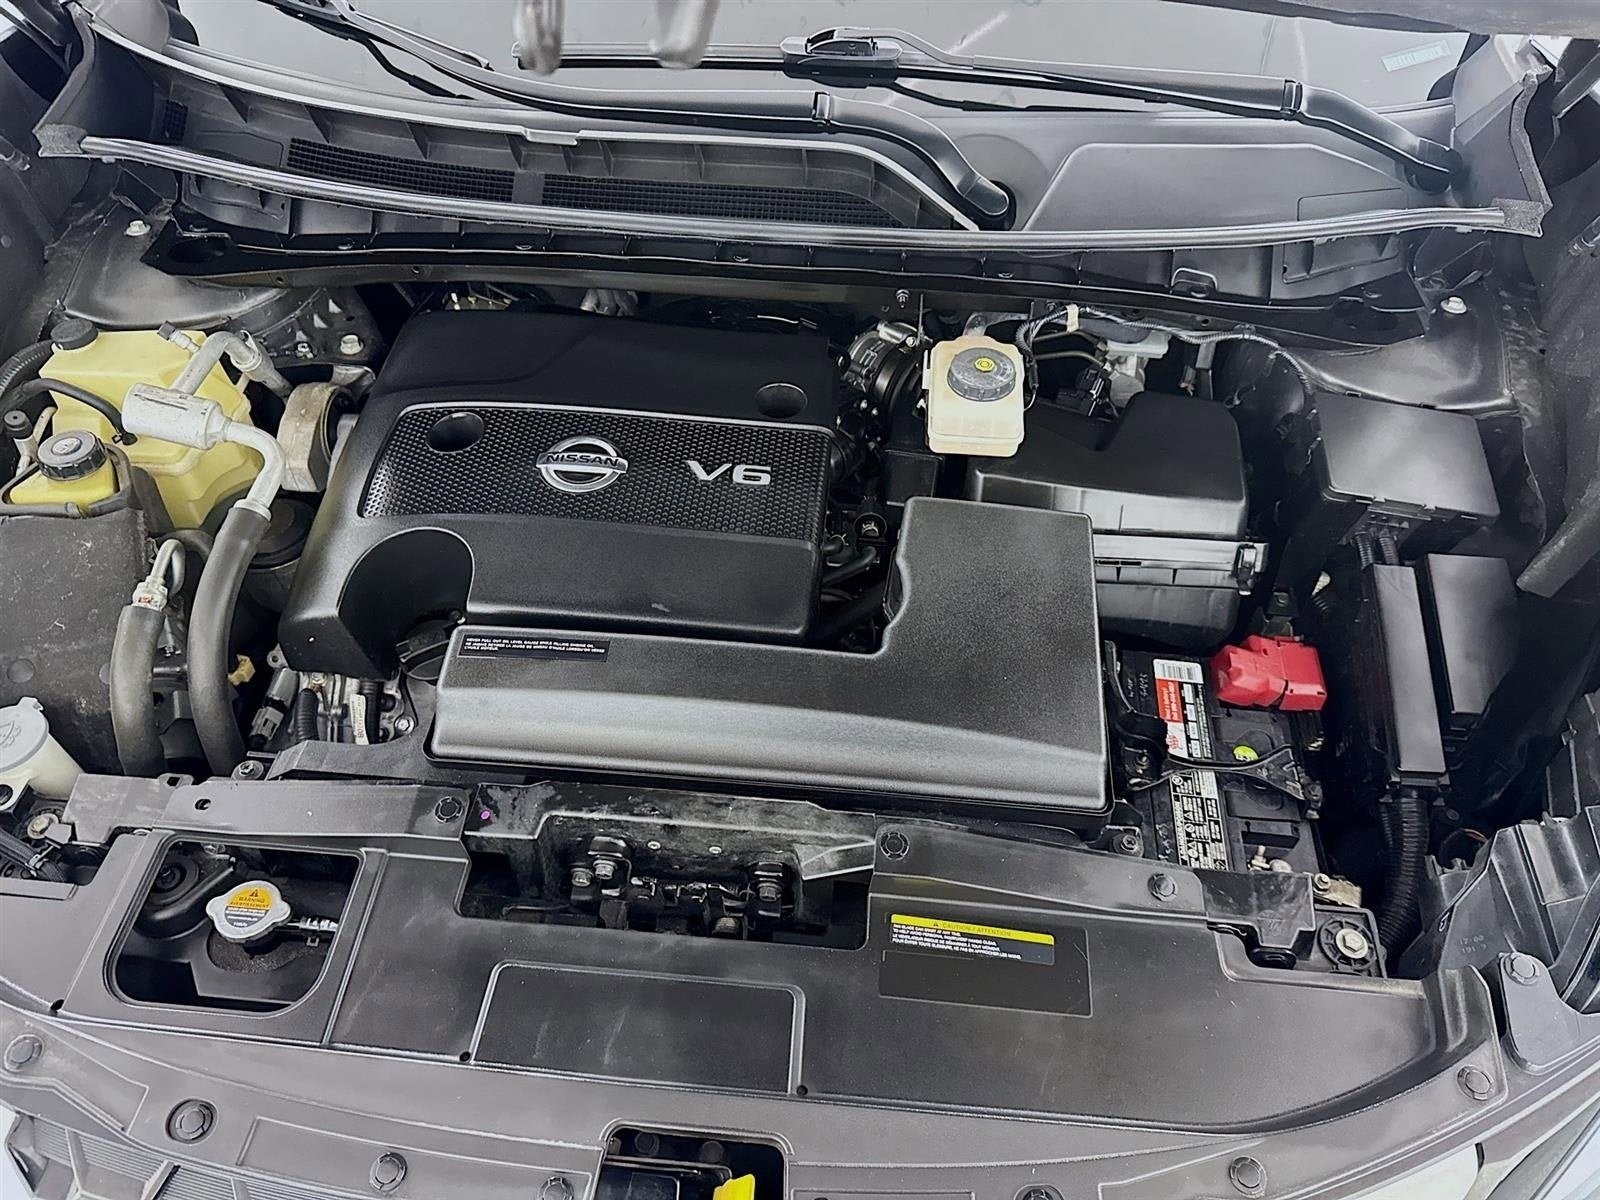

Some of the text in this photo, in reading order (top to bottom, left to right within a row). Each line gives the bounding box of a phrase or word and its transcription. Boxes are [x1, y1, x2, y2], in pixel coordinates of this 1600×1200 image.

[546, 453, 619, 466] NISSAN
[686, 460, 772, 486] V6
[942, 923, 970, 931] CAUTION
[976, 927, 1011, 937] ATTENTION
